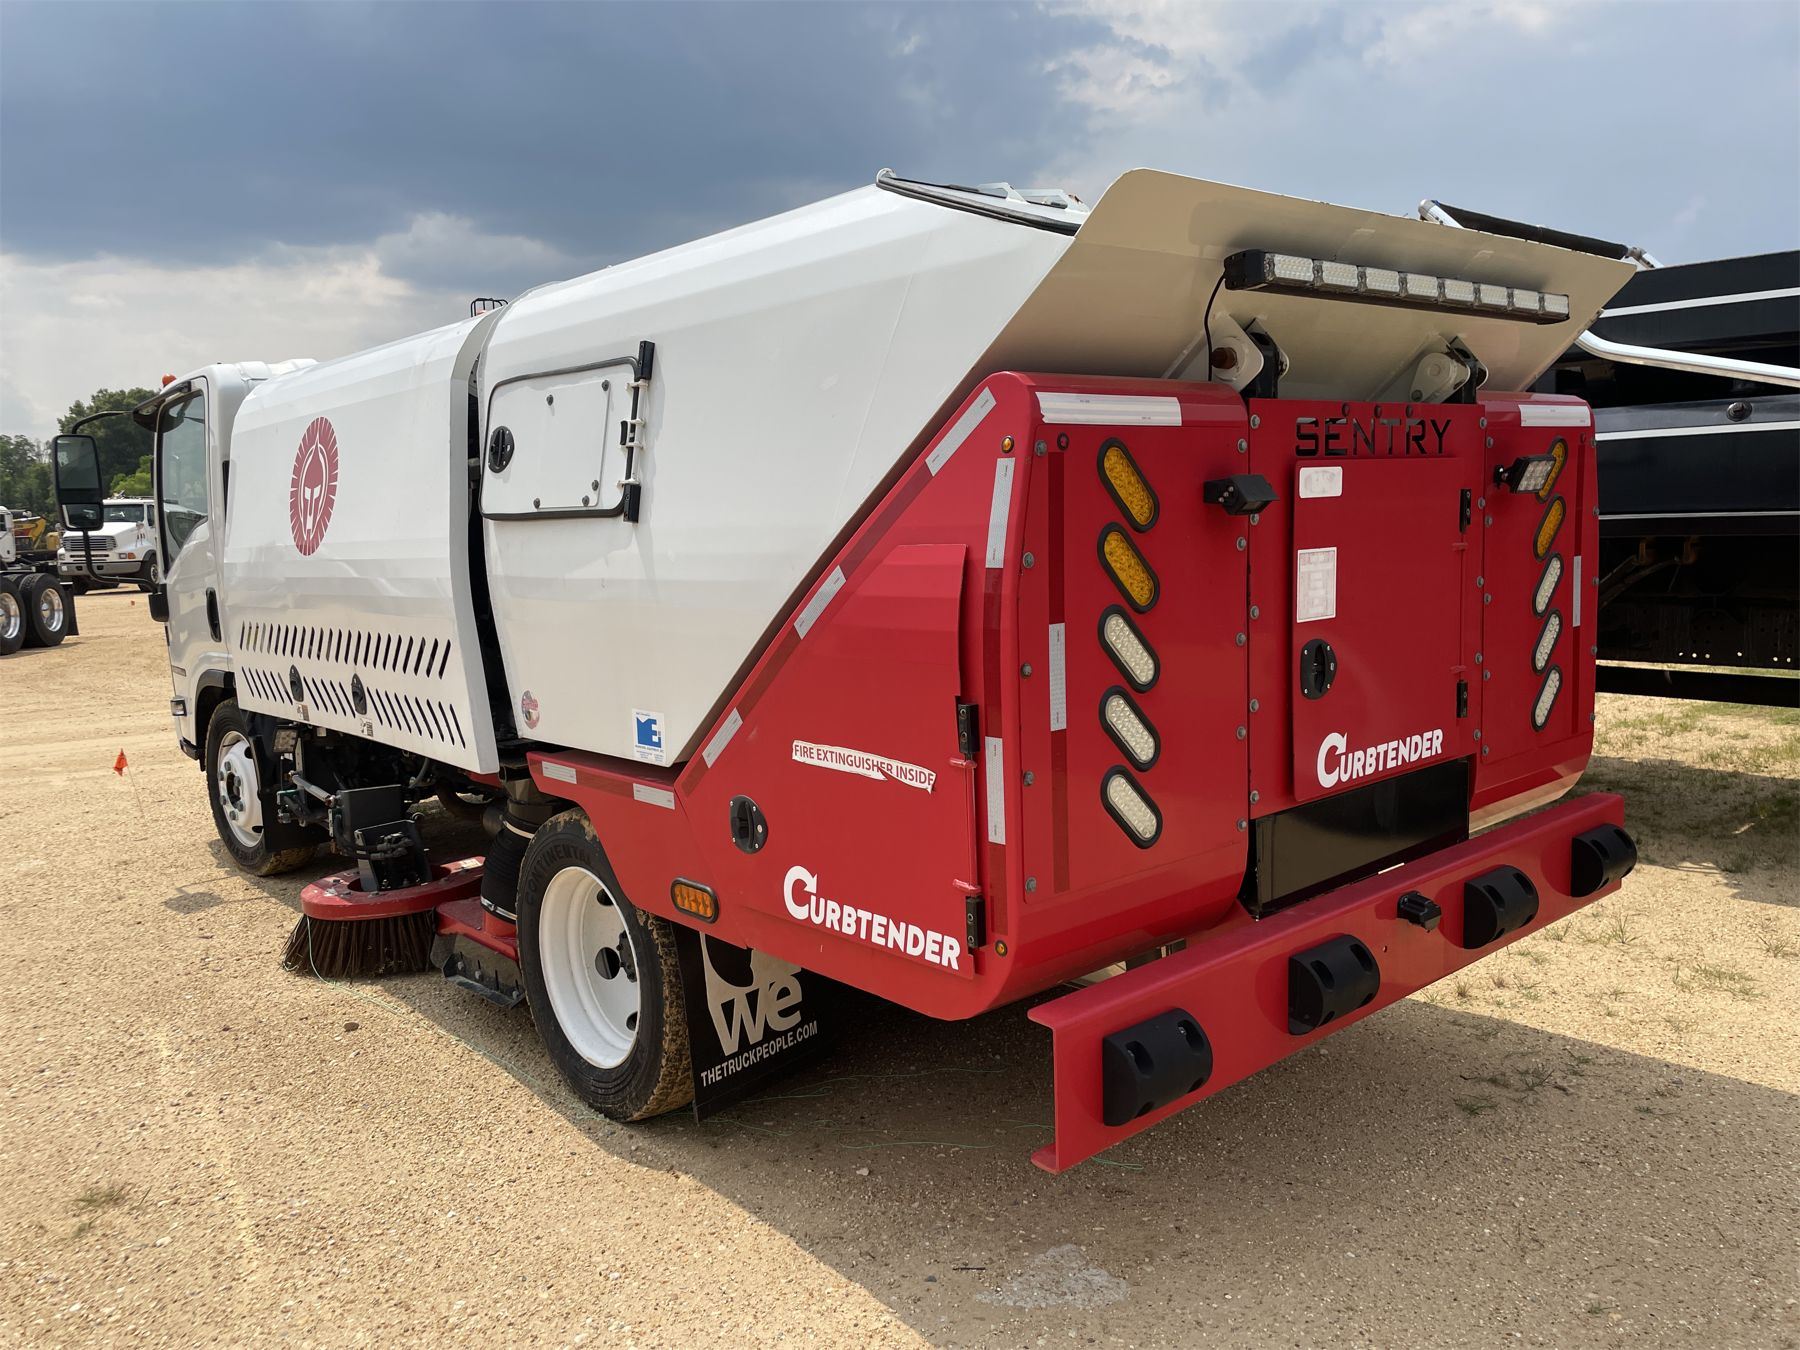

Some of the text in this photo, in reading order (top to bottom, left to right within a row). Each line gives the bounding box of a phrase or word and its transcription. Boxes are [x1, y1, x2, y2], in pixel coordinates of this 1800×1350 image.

[1295, 417, 1452, 456] SENTRY
[794, 744, 934, 786] FIRE EXTINGUISHER INSIDE
[1316, 728, 1443, 788] CURBTENDER
[783, 865, 961, 970] CURBTENDER
[701, 1020, 818, 1088] THETRUCKPEOPLE.COM
